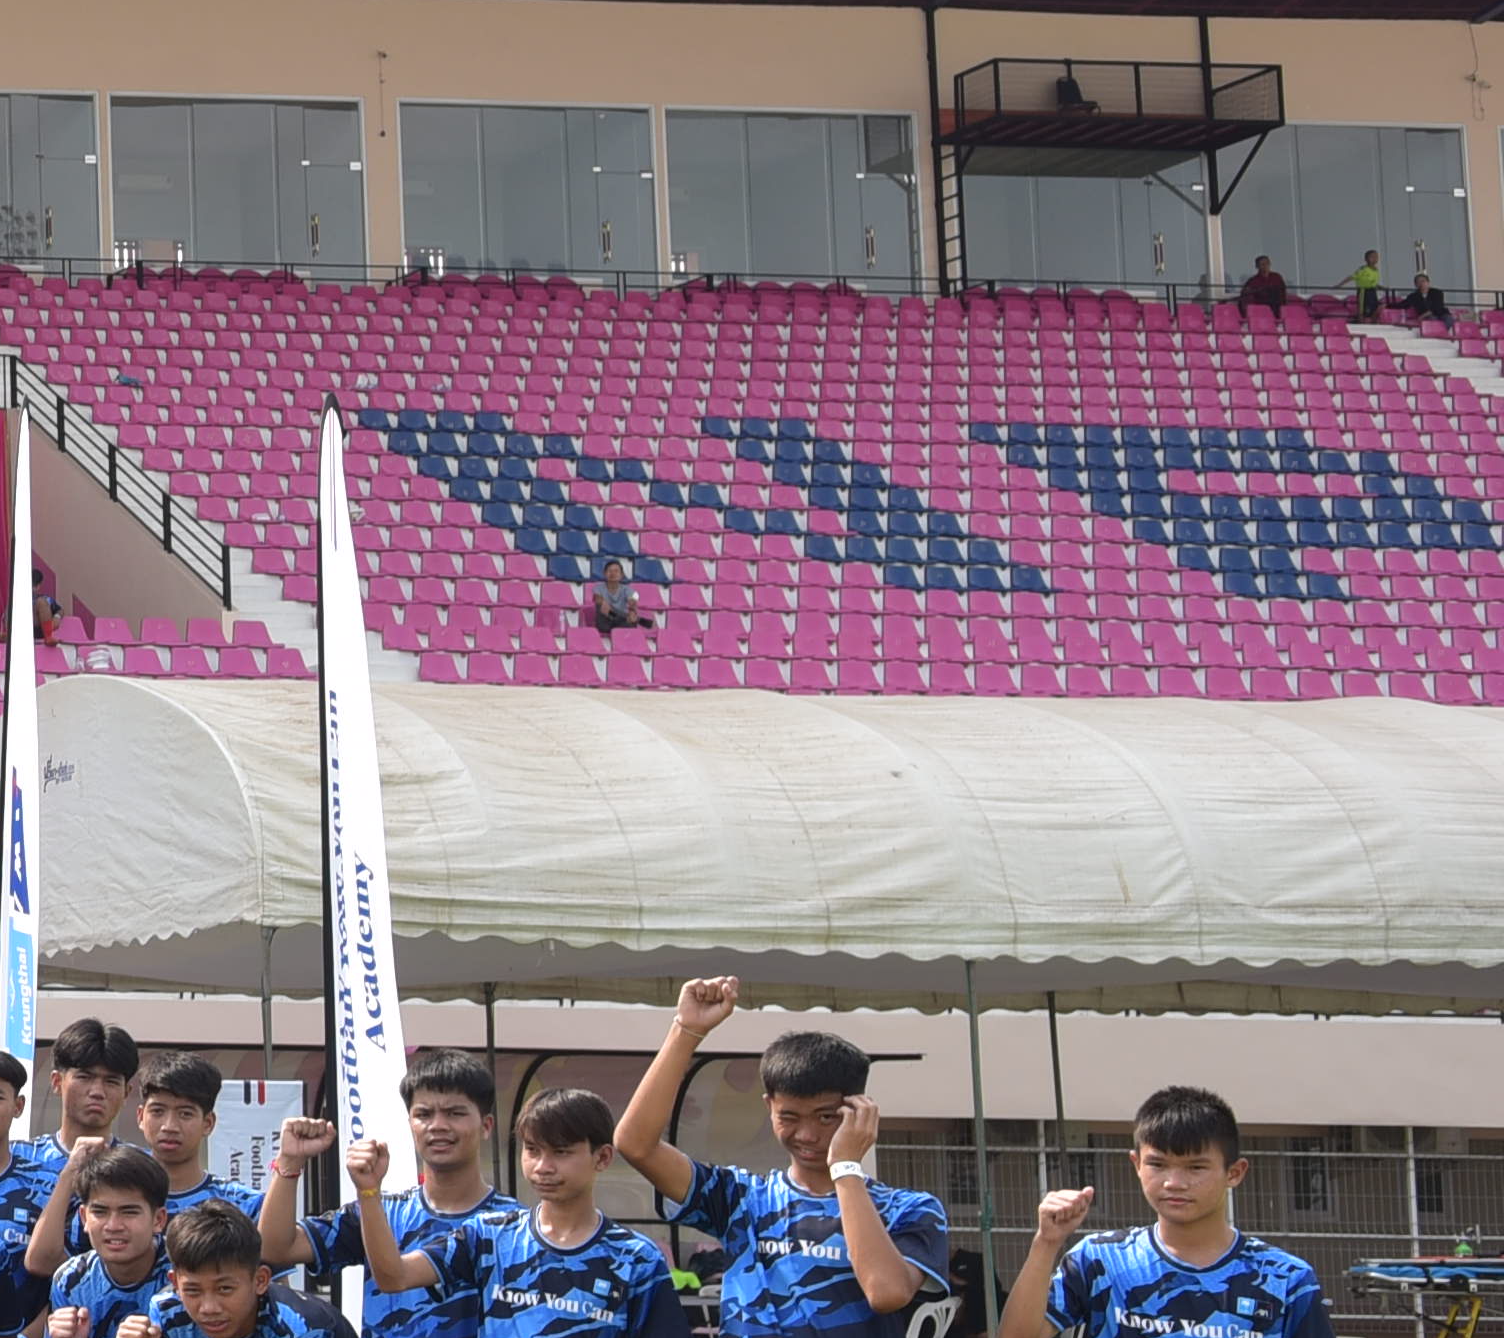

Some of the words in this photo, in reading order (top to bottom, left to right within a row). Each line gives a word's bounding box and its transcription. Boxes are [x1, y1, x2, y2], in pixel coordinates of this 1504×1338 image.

[354, 850, 387, 1054] Academy
[16, 946, 33, 1045] Krungthai
[251, 1136, 266, 1190] Footba
[758, 1238, 794, 1255] now
[799, 1239, 841, 1260] You
[544, 1295, 579, 1314] You
[581, 1302, 614, 1323] Can
[1114, 1307, 1176, 1335] Know
[1180, 1318, 1224, 1338] You
